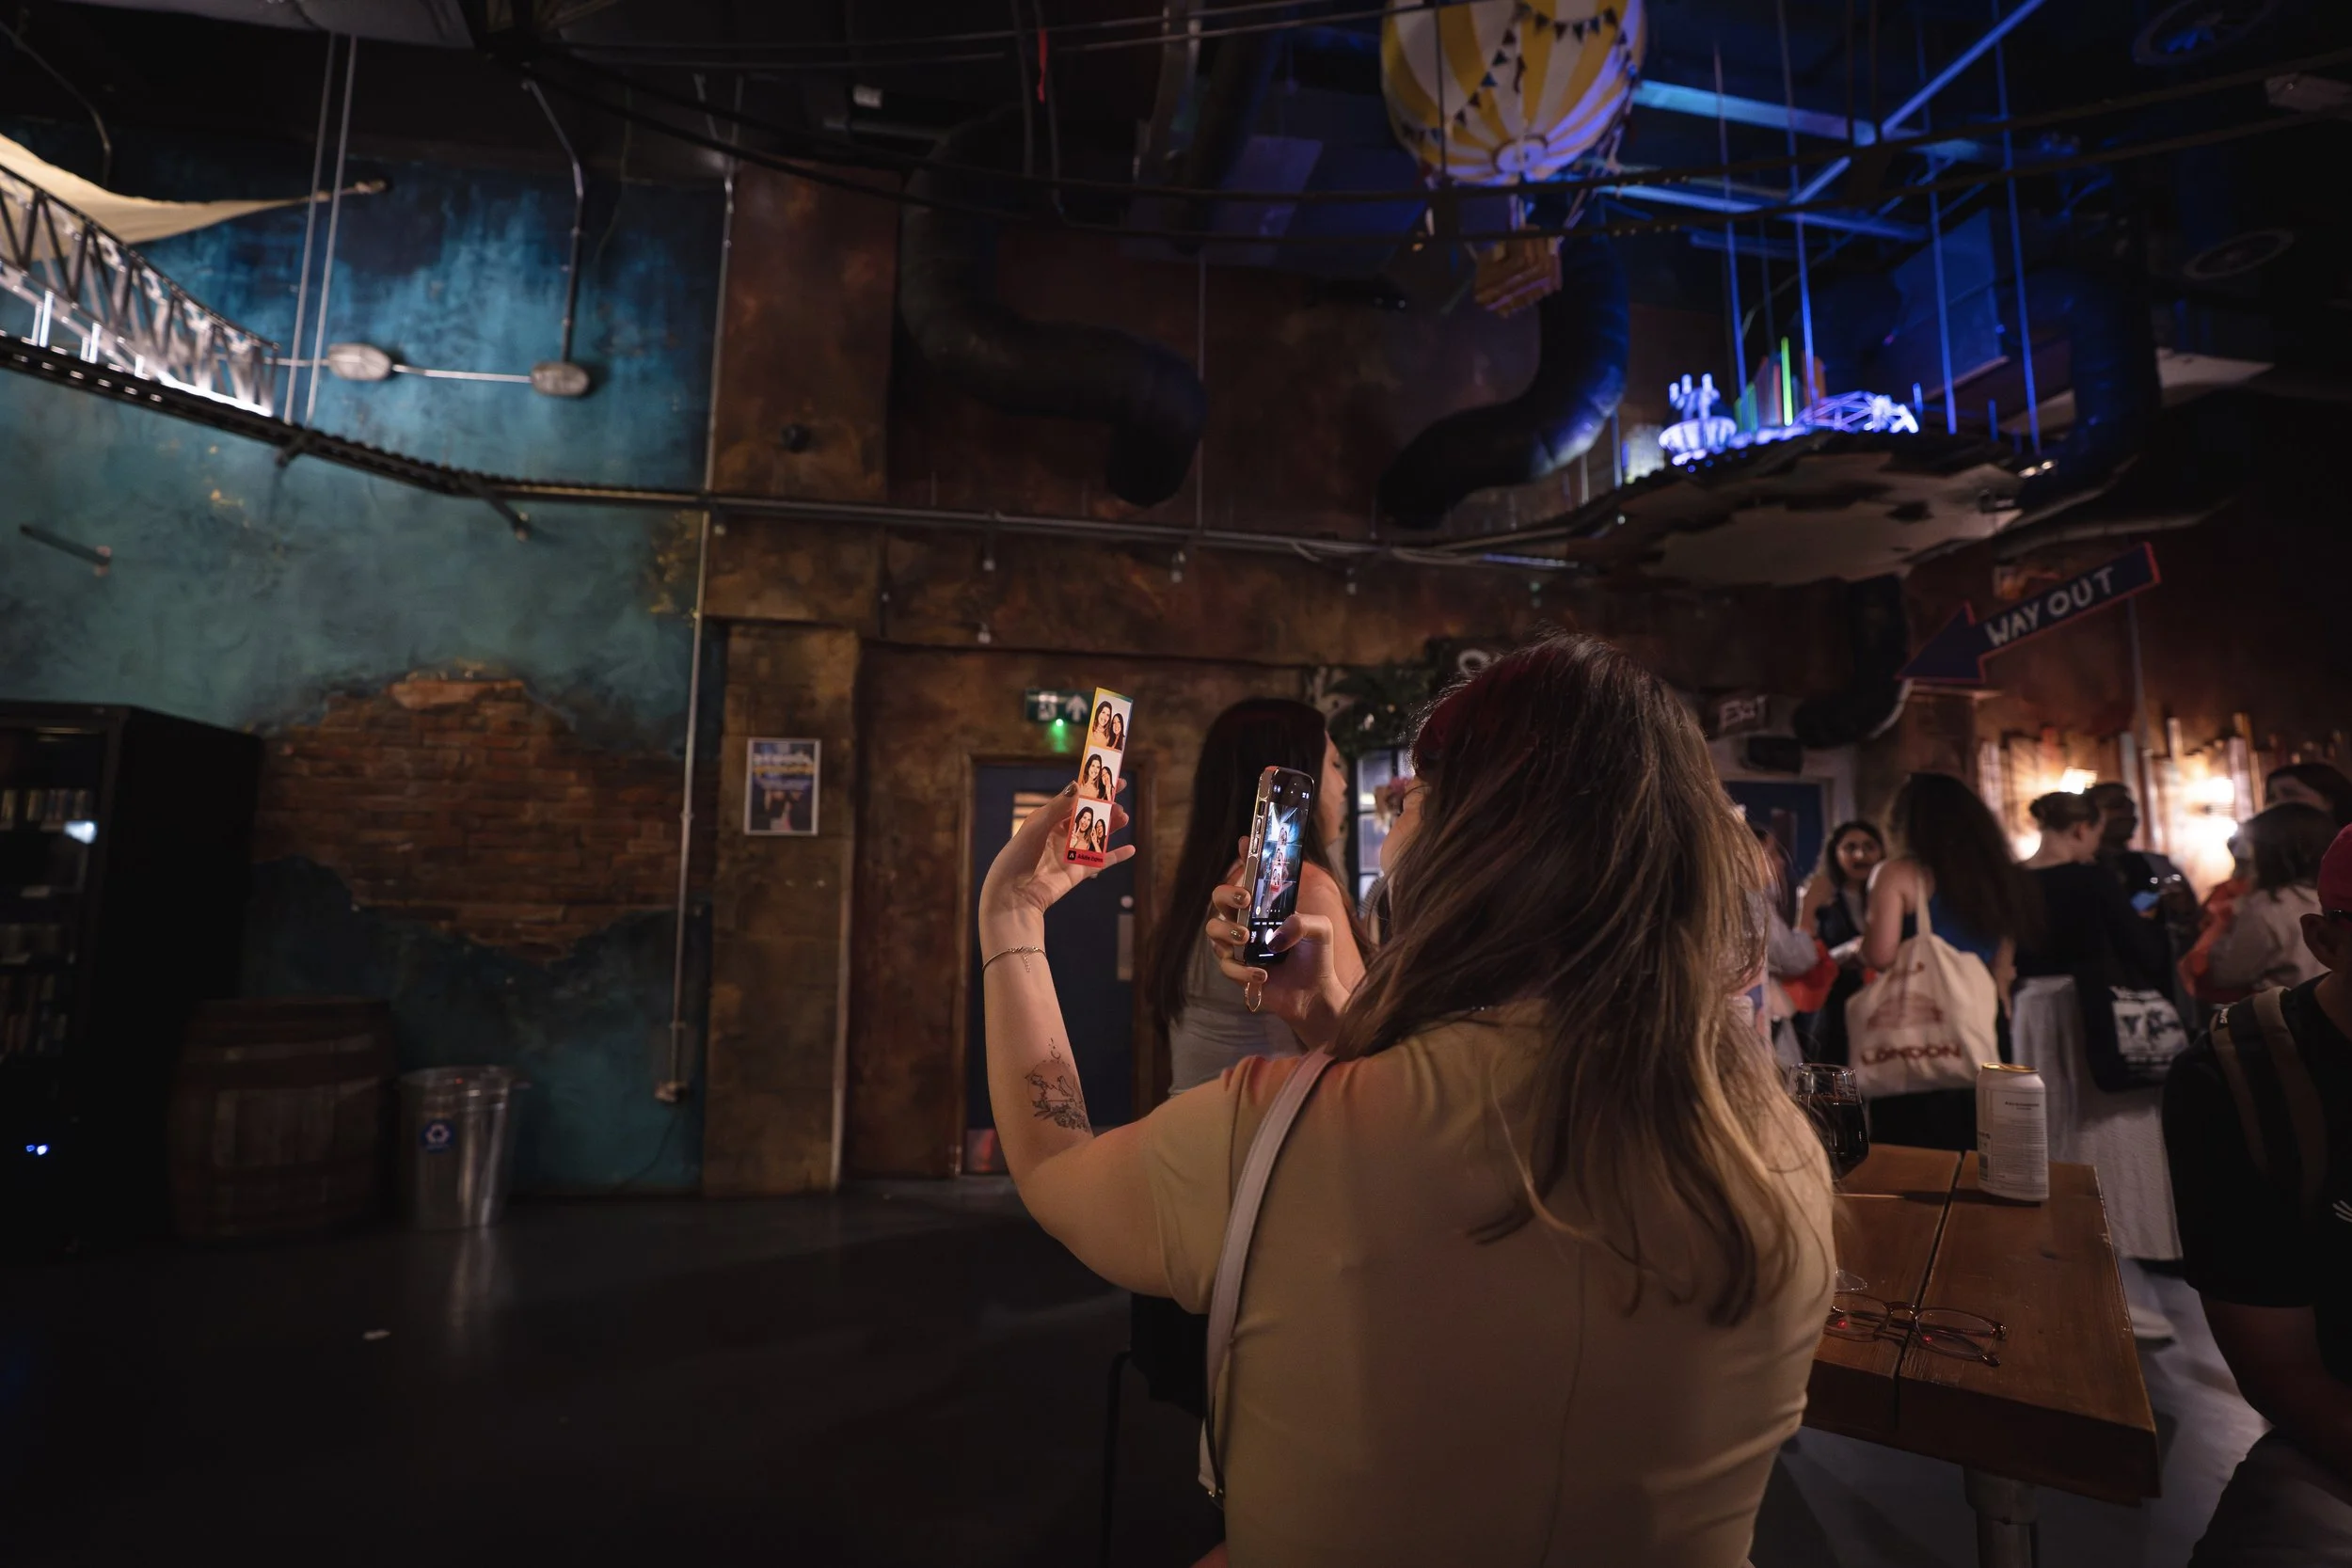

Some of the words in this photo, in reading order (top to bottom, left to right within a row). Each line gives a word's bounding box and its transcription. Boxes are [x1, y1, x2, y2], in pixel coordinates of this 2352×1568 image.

[1984, 601, 2041, 647] WAY
[2047, 566, 2115, 617] OUT
[1862, 1043, 1962, 1066] LONDON
